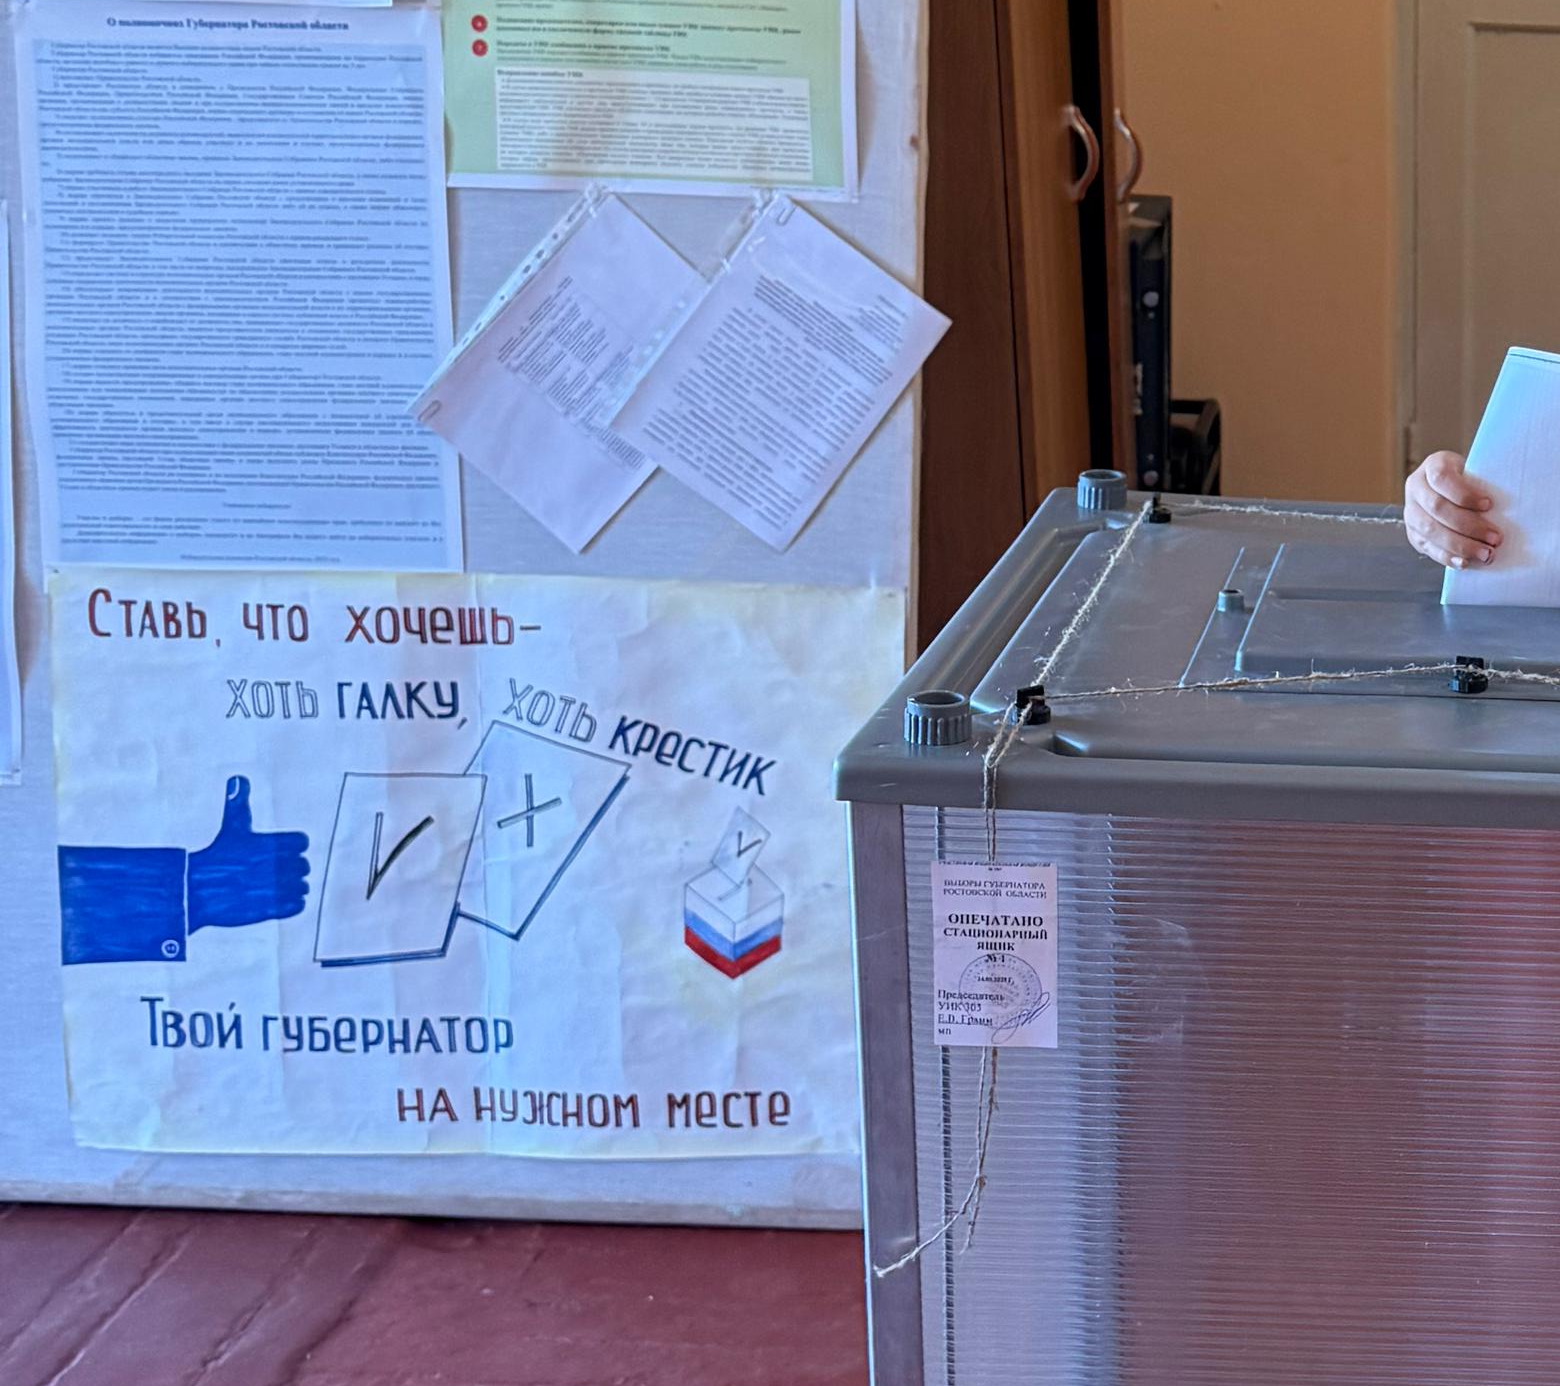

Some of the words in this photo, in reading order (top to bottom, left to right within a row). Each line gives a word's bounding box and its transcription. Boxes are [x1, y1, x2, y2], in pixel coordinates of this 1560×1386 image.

[948, 913, 1044, 927] ОПЕЧАТАНО
[943, 927, 1048, 940] СТАЦИОНАРНЫЙ
[977, 941, 1015, 951] ЯЩИК
